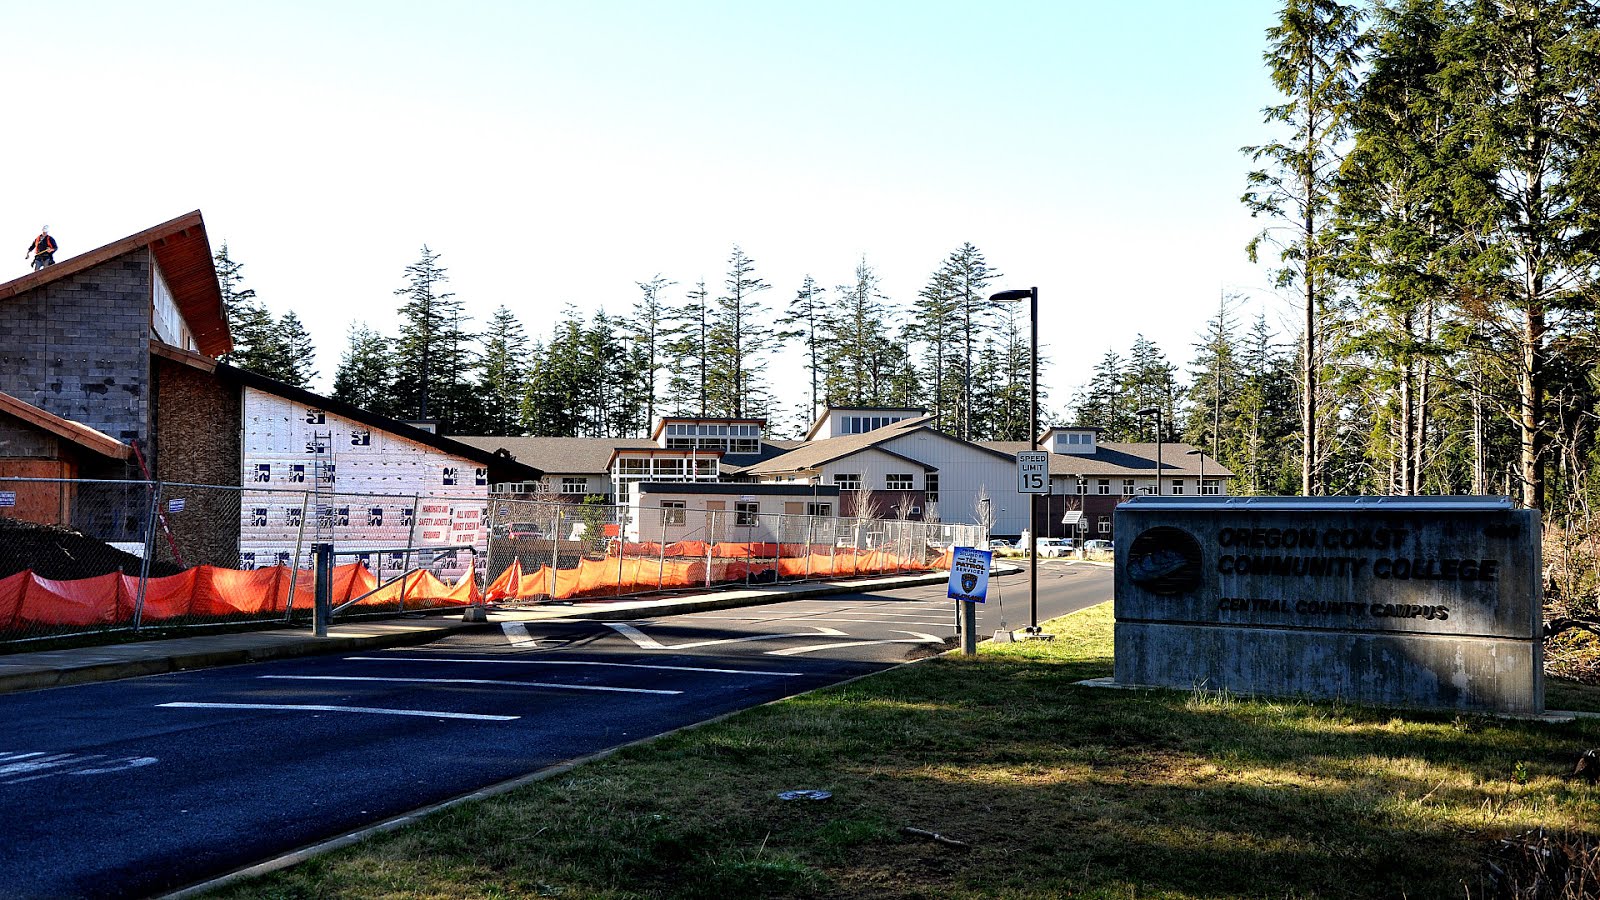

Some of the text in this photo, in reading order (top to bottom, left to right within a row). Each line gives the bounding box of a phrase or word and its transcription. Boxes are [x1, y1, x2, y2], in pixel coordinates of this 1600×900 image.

[1023, 473, 1043, 489] 15
[418, 518, 433, 526] SAFETY
[453, 522, 464, 530] MUST
[464, 522, 476, 530] CHECK
[423, 531, 441, 539] REQUIRED
[462, 534, 475, 543] OFFICE
[1219, 527, 1409, 550] OREGON COAST
[956, 561, 986, 571] PATROL
[956, 566, 984, 575] SERVICES
[1218, 555, 1498, 581] COMMUNITY COLLEGE
[1218, 597, 1450, 620] CENTRAL COUNTY CAMPUS
